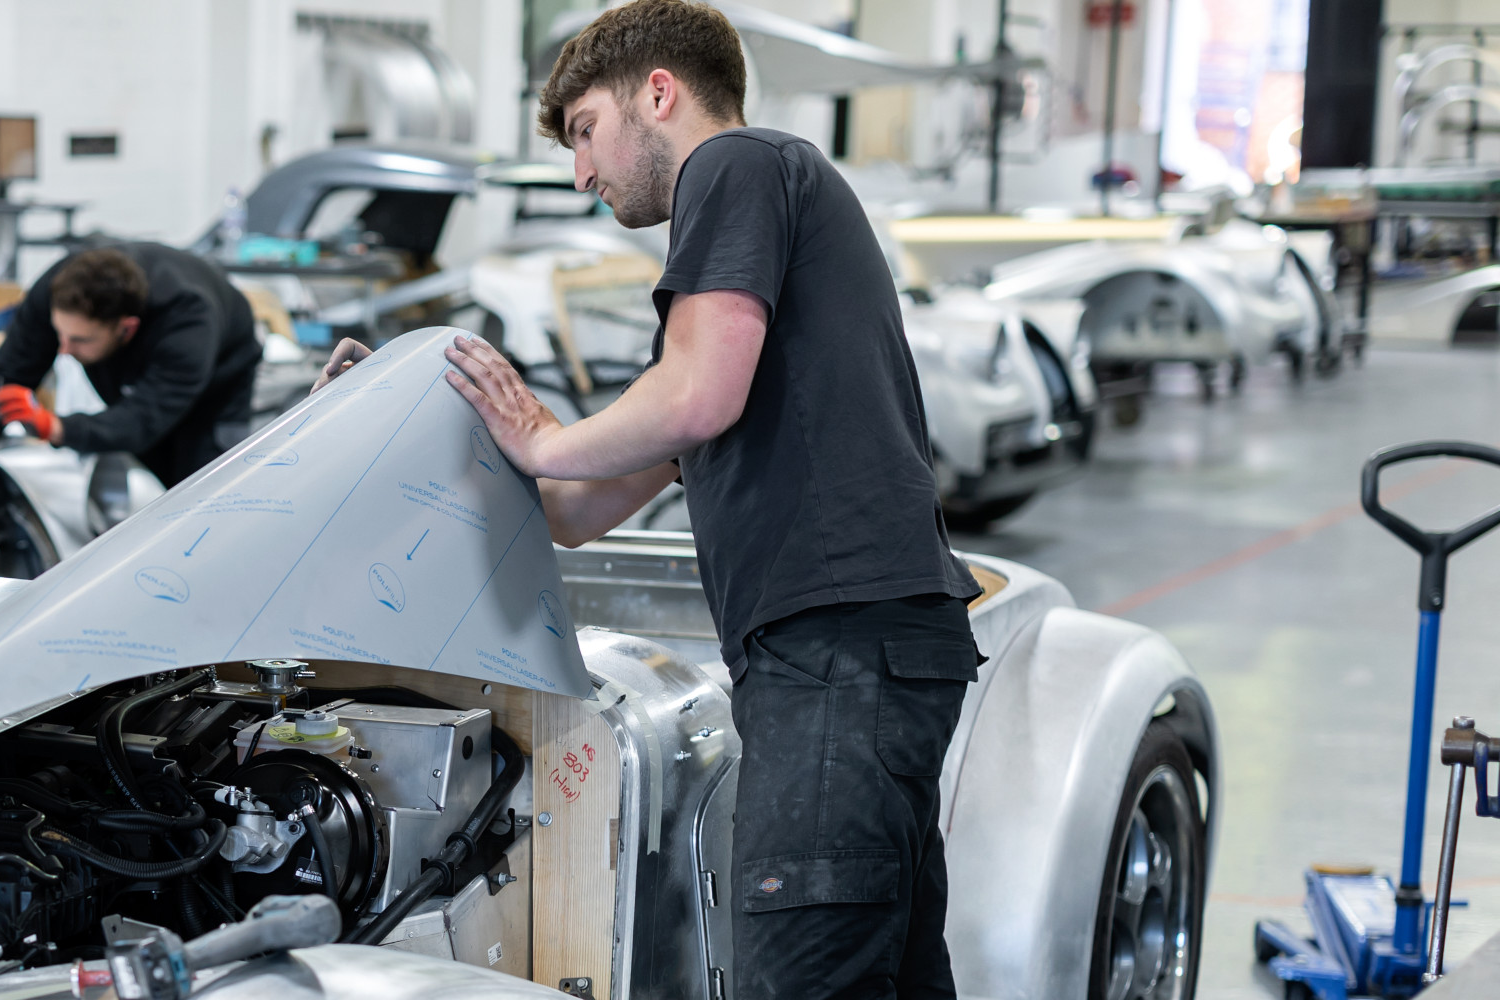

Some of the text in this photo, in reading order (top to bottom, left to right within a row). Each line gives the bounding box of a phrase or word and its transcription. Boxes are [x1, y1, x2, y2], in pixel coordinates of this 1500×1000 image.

[398, 481, 488, 523] UNIVERSAL LASER-FILM
[428, 480, 458, 498] POLIFILM
[372, 568, 402, 609] POLIFILM
[288, 627, 340, 650] UNIVERSAL
[321, 624, 357, 642] POLIFILM
[476, 647, 557, 690] UNIVERSAL LASER-FILM
[501, 647, 528, 665] POLIFILM
[563, 751, 590, 783] 803
